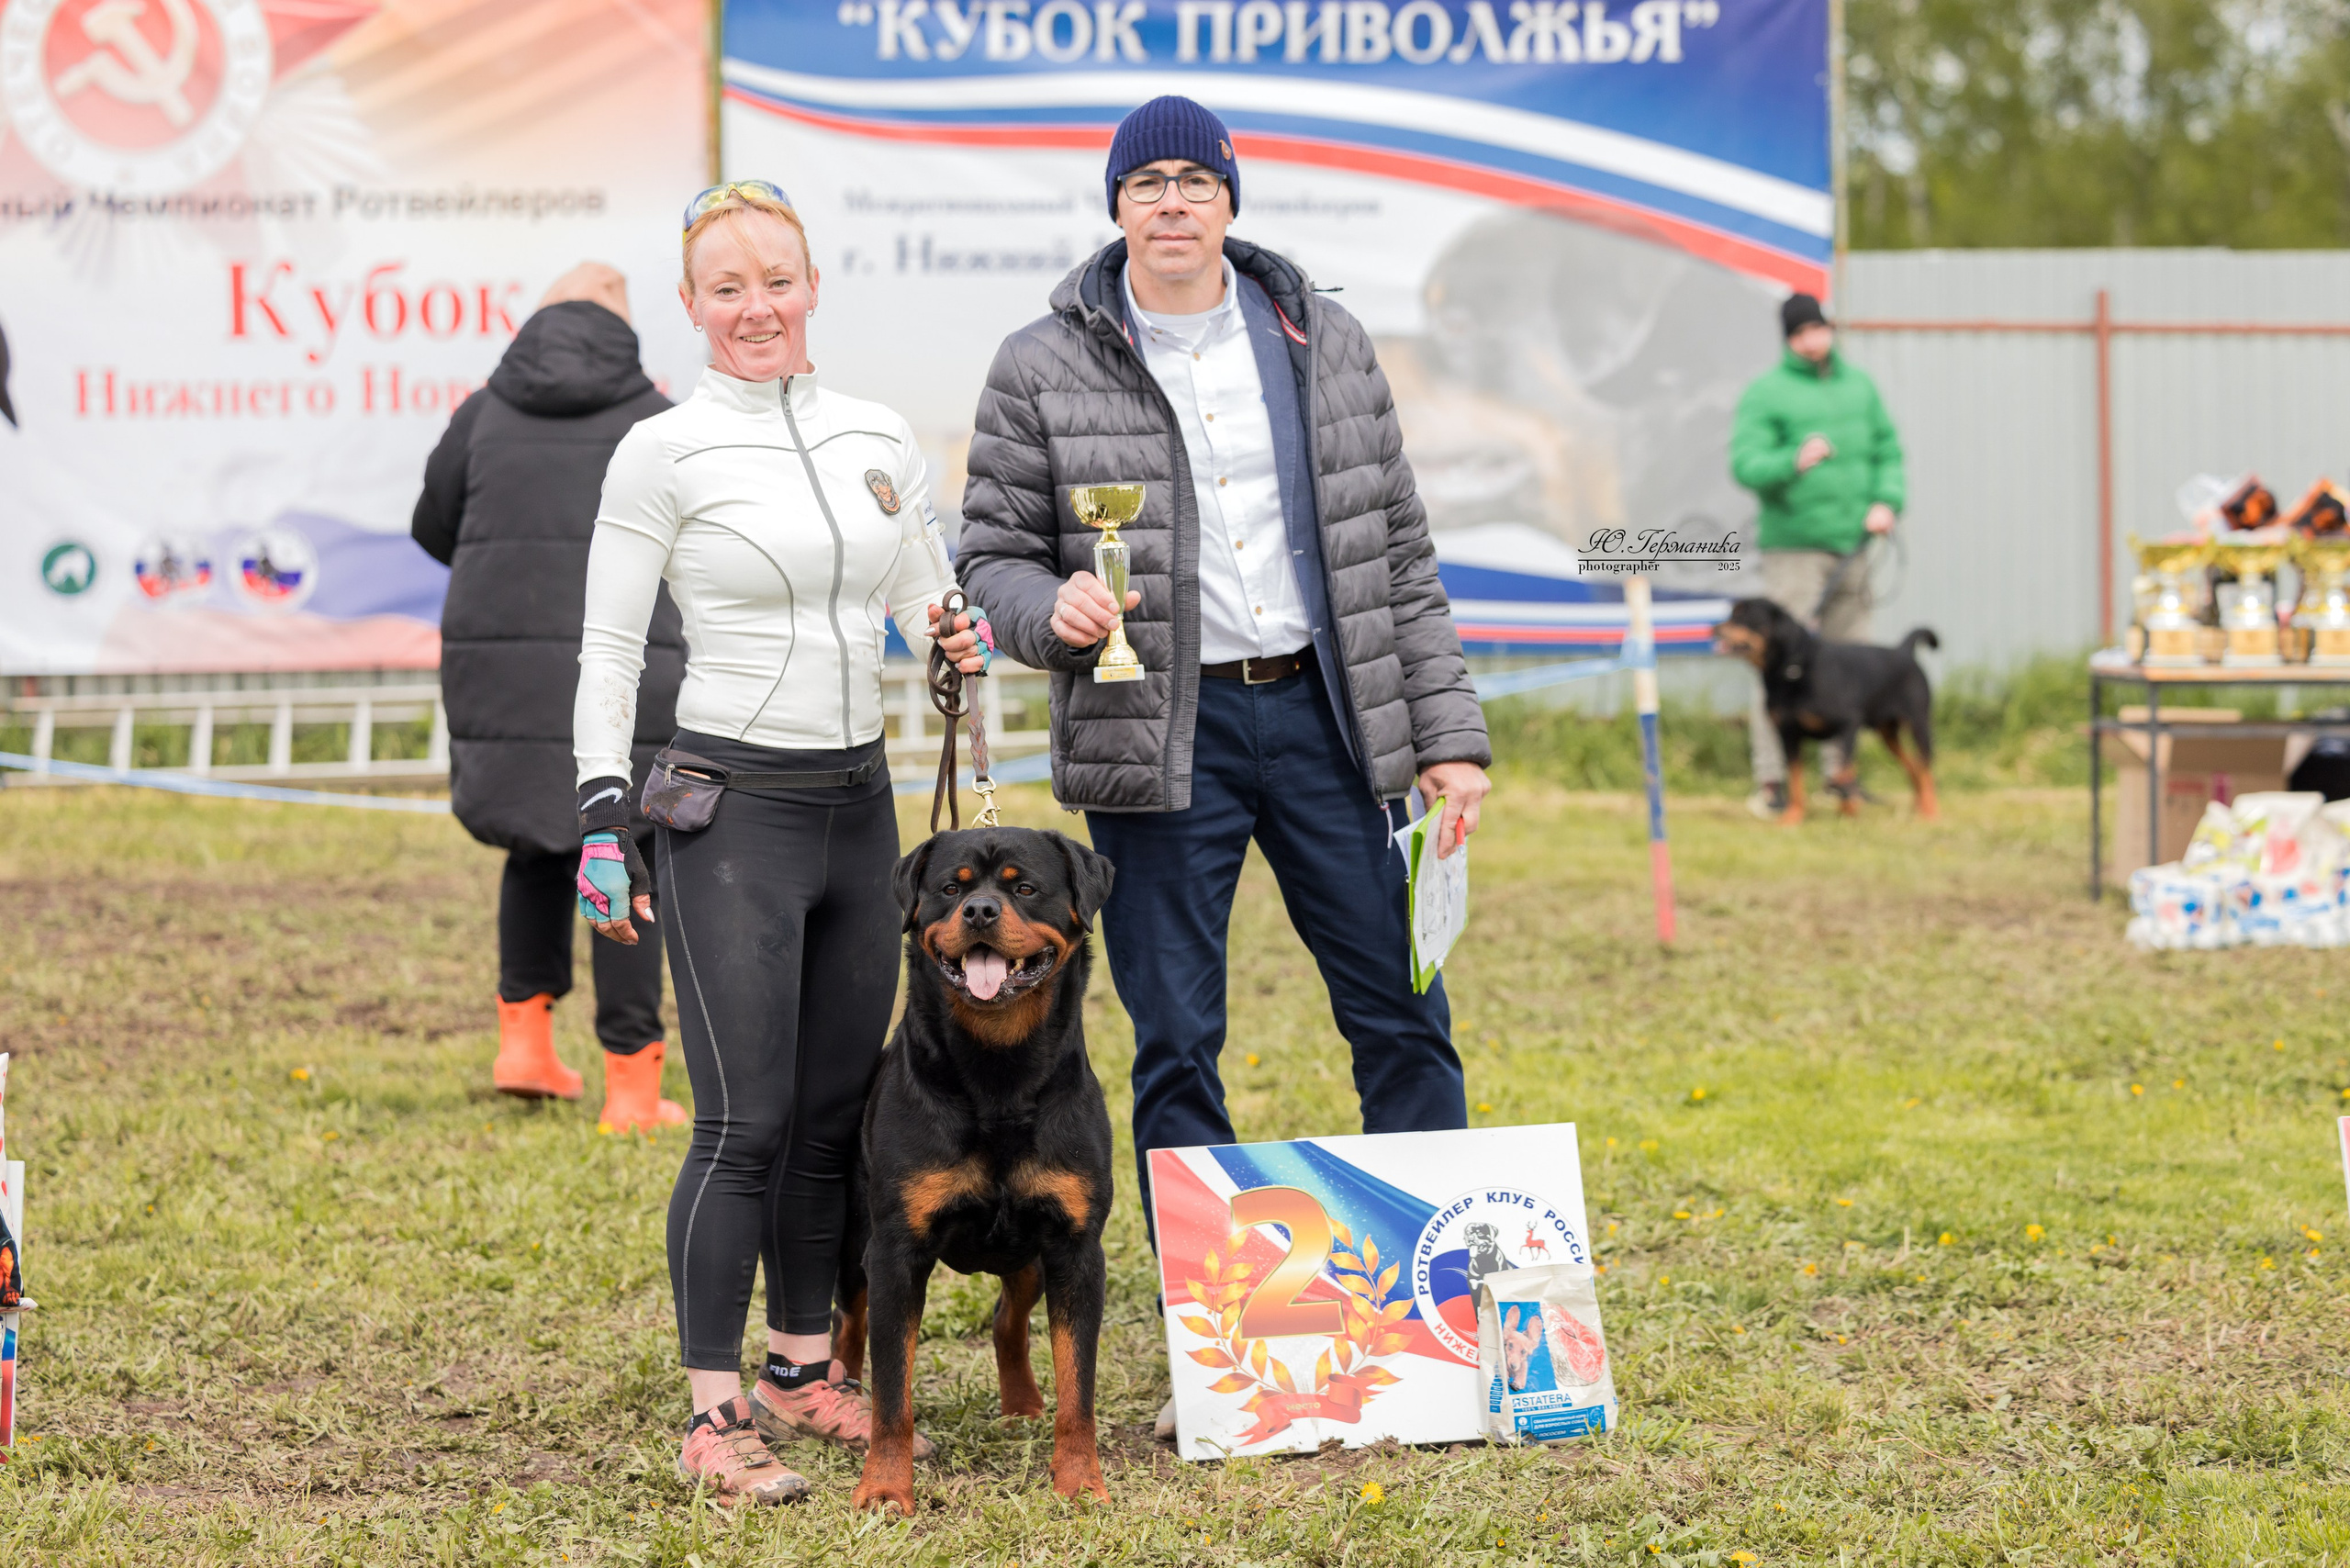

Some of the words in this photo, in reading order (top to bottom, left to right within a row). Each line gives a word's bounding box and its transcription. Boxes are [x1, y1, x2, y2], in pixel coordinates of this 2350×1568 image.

[837, 0, 1147, 62] “КУБОК
[1175, 0, 1719, 64] ПРИВОЛЖЬЯ”
[226, 261, 524, 364] Кубок
[74, 367, 336, 420] Нижнего
[1228, 1185, 1346, 1341] 2
[1416, 1196, 1473, 1295] РОТВЕЙЛЕР
[1486, 1192, 1536, 1210] КЛУБ
[1434, 1322, 1480, 1361] НИЖЕ
[1521, 1393, 1572, 1406] STATERA
